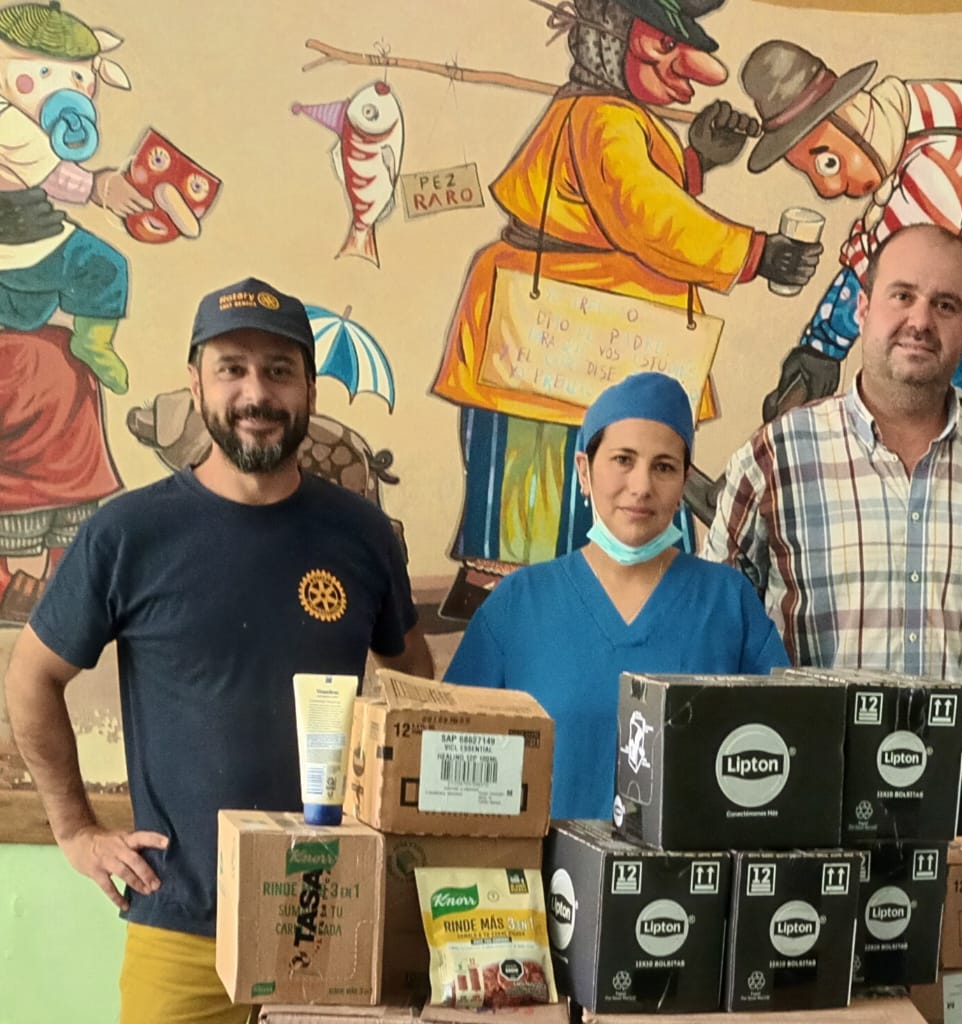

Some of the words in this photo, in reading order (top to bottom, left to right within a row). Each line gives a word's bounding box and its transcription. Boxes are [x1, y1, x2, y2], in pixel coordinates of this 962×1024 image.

[419, 172, 456, 191] PEZ
[413, 187, 473, 211] RARO
[860, 696, 878, 712] 12
[394, 723, 411, 738] 12
[441, 734, 457, 744] SAP
[727, 756, 779, 776] Lipton
[884, 752, 919, 765] Lipton
[618, 865, 637, 879] 12
[753, 868, 771, 882] 12
[263, 881, 297, 897] RINDE
[330, 884, 338, 898] 3
[293, 869, 323, 947] TASA
[433, 893, 476, 908] Knorr
[551, 894, 571, 921] Lipton
[872, 907, 905, 920] Lipton
[444, 918, 476, 933] RINDE
[481, 915, 505, 931] MÁS
[643, 921, 681, 935] Lipton
[777, 922, 813, 936] Lipton
